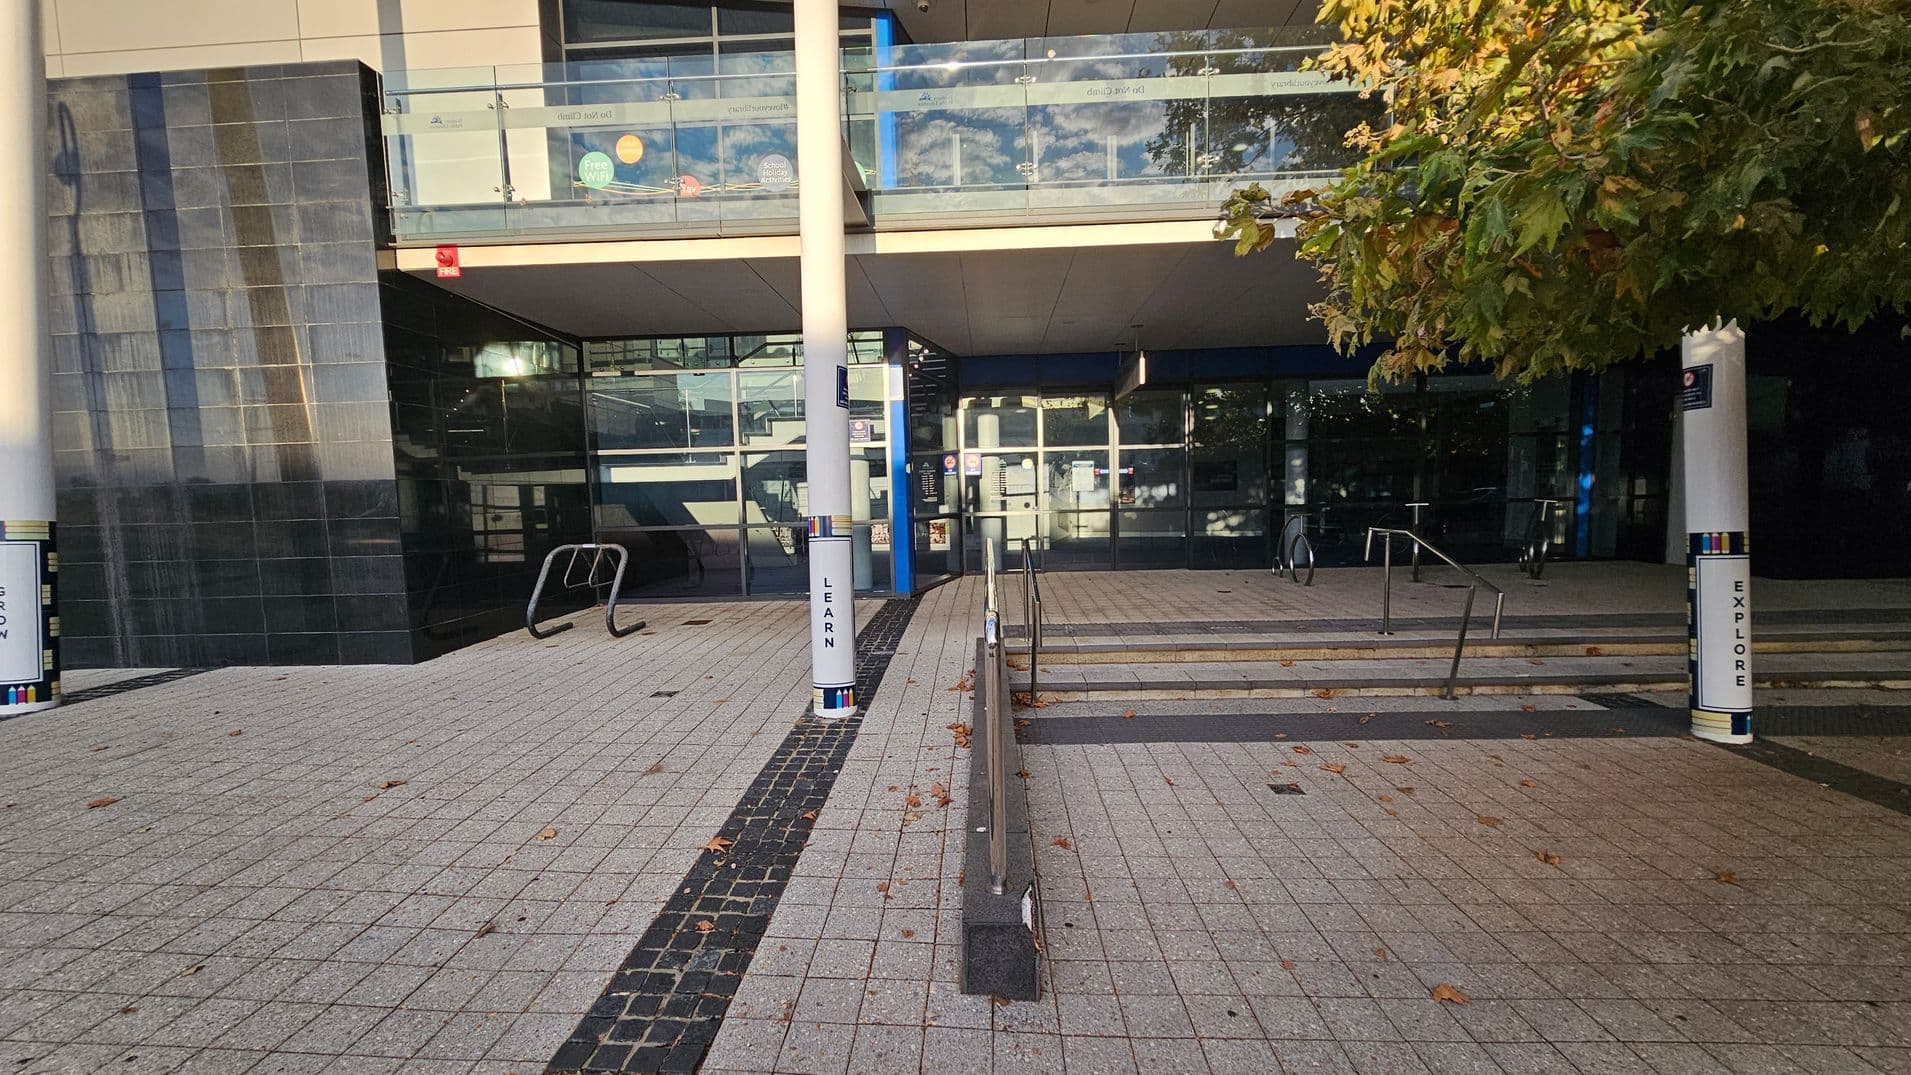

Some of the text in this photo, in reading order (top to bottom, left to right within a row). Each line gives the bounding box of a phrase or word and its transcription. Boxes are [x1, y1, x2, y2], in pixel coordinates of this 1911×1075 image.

[584, 159, 608, 170] Free
[763, 160, 787, 169] School
[584, 171, 609, 182] WiFi
[762, 168, 788, 178] Holiday
[760, 176, 792, 184] Activities
[438, 267, 459, 278] FIRE
[823, 577, 835, 648] LEARN
[1733, 581, 1746, 687] EXPLORE
